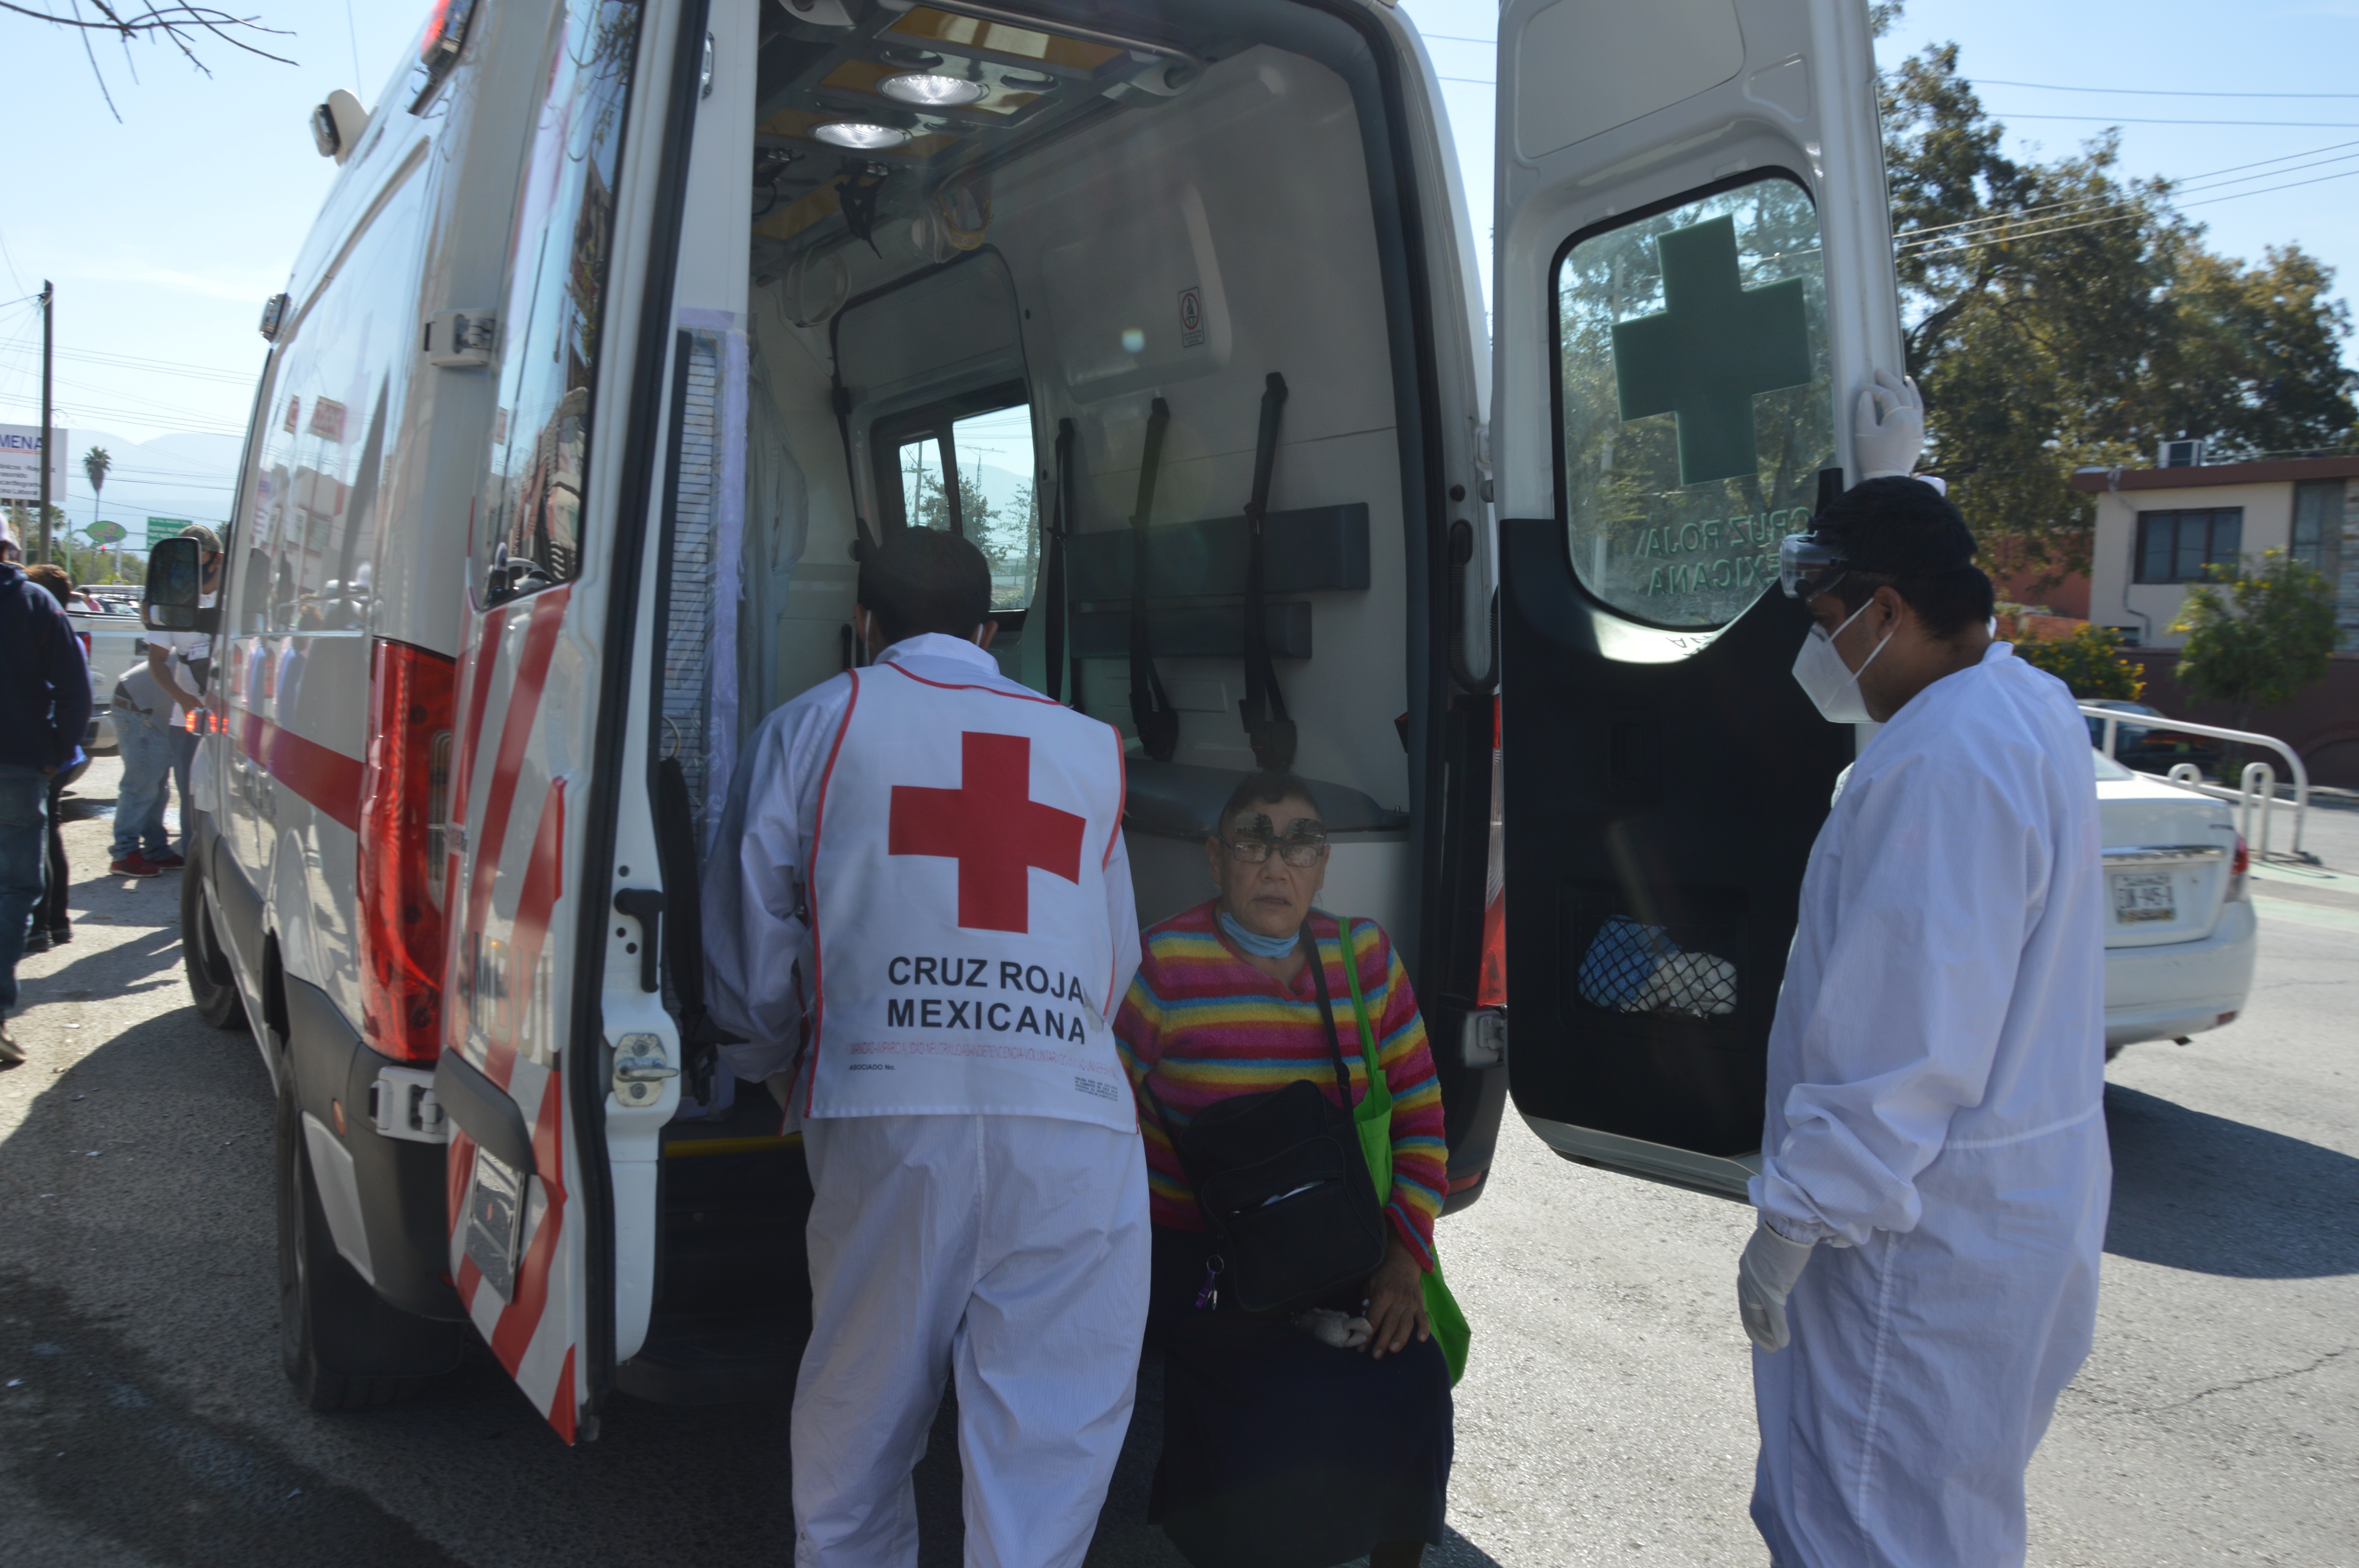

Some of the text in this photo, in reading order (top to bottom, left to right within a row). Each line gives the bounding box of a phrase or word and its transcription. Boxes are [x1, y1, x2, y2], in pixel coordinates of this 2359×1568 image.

[888, 956, 1084, 1005] CRUZ ROJA
[888, 999, 1085, 1045] MEXICANA
